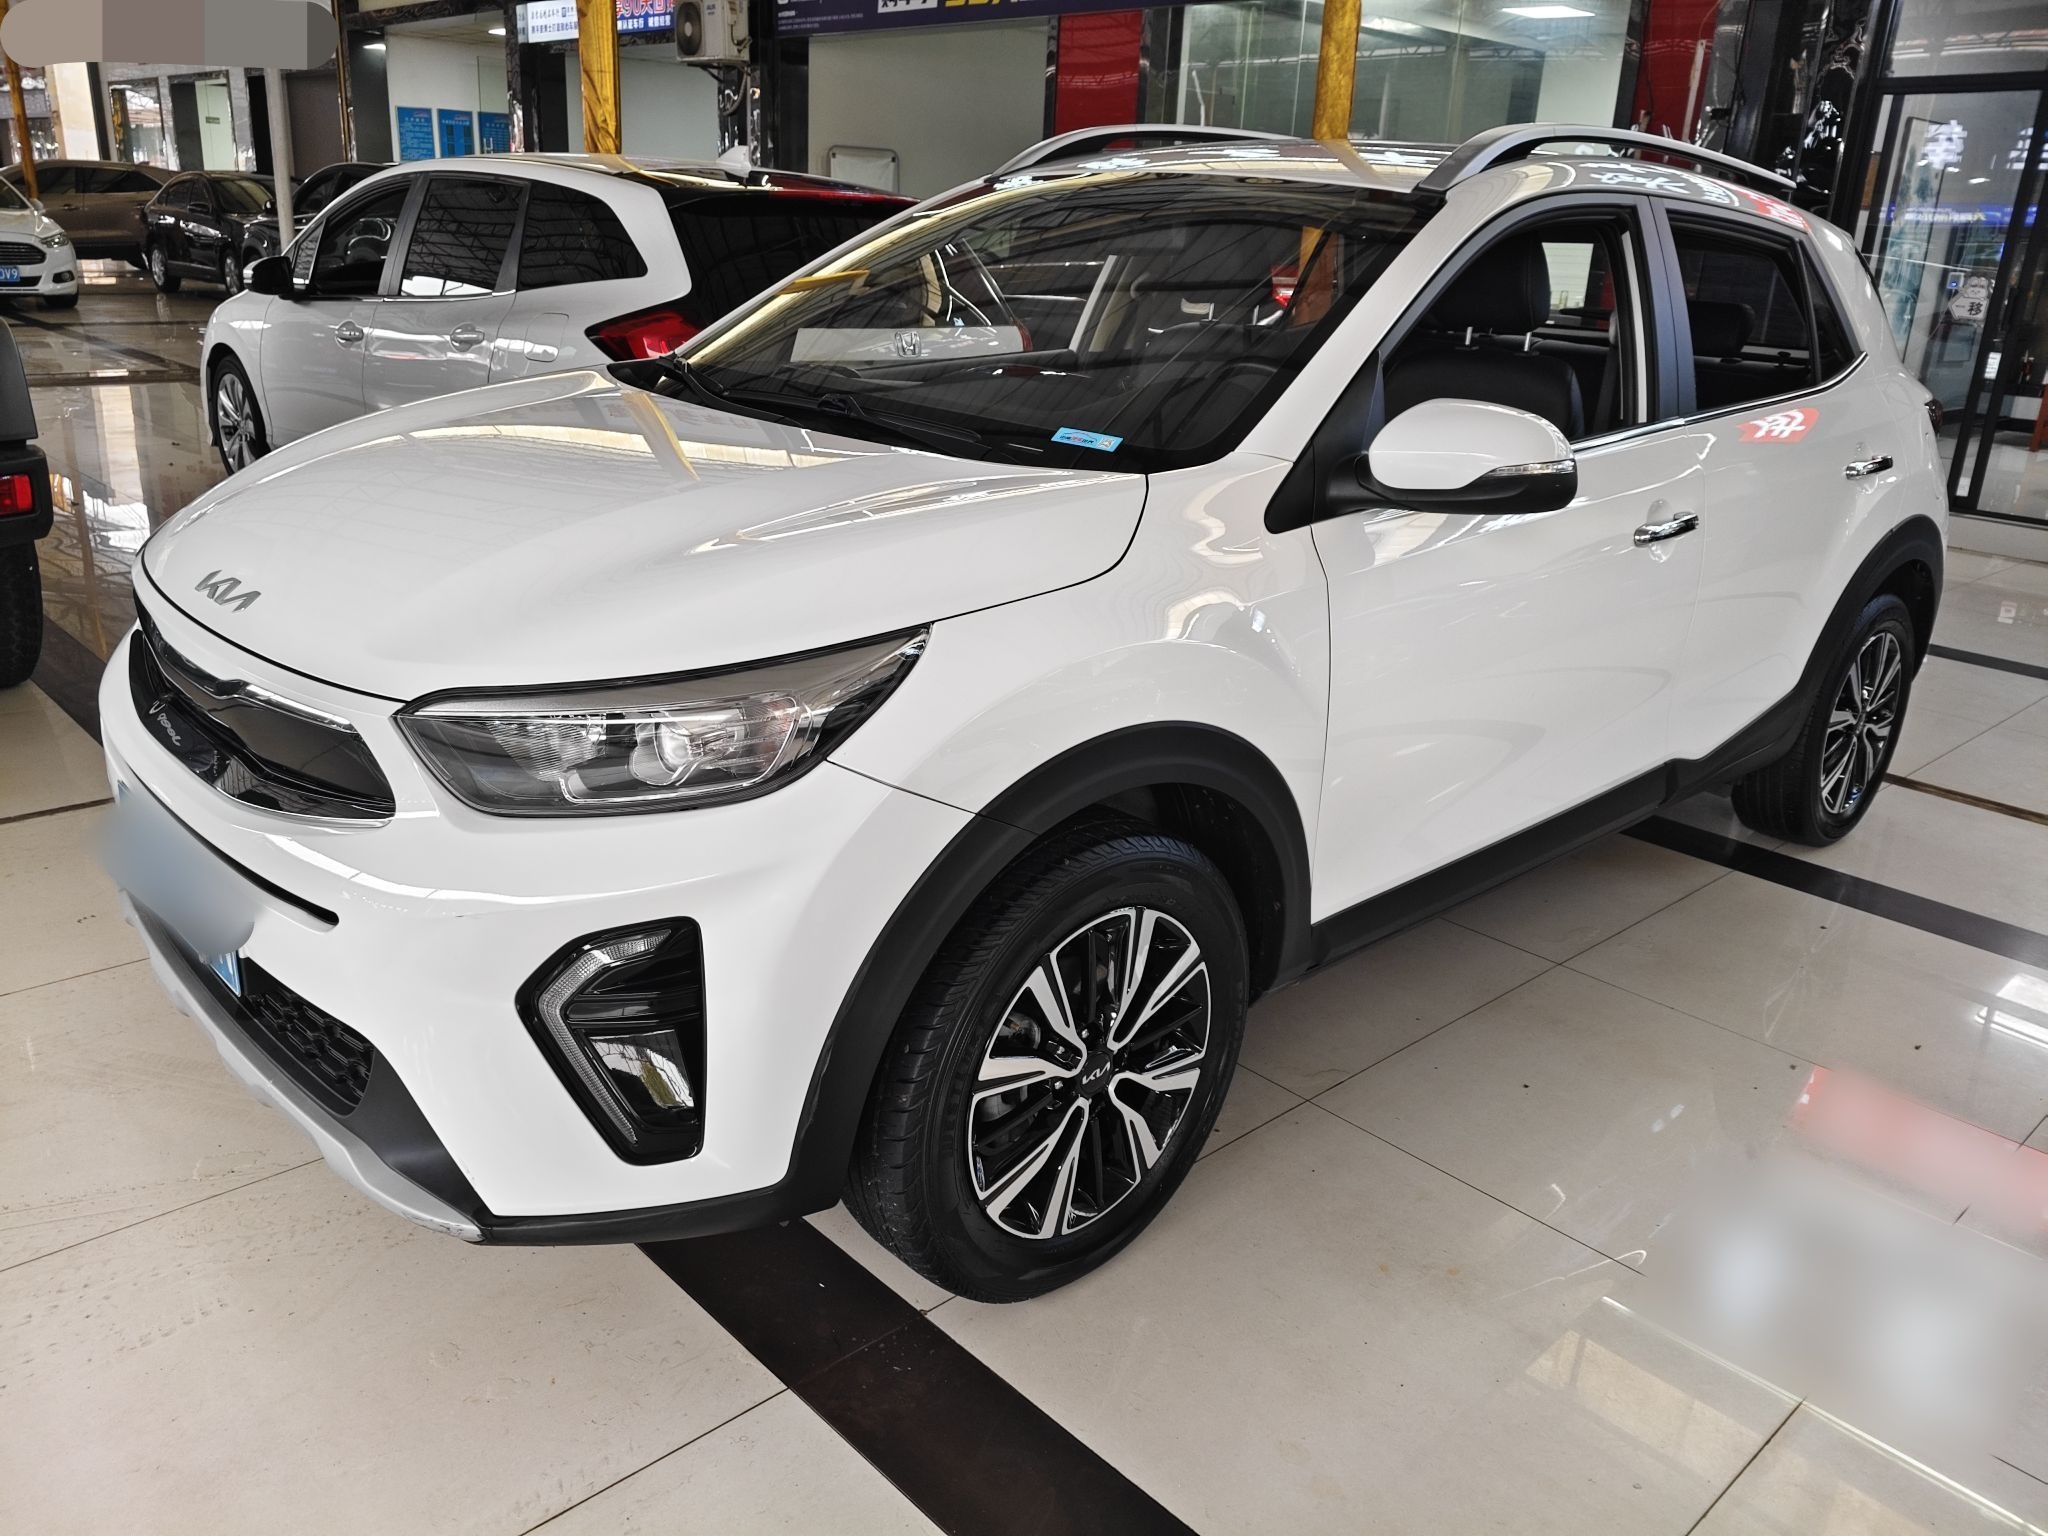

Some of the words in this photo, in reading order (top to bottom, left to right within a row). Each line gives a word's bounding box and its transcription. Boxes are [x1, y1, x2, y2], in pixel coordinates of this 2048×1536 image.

[1967, 302, 1984, 316] 移
[195, 570, 261, 612] KIA
[1082, 1061, 1110, 1084] KIA
